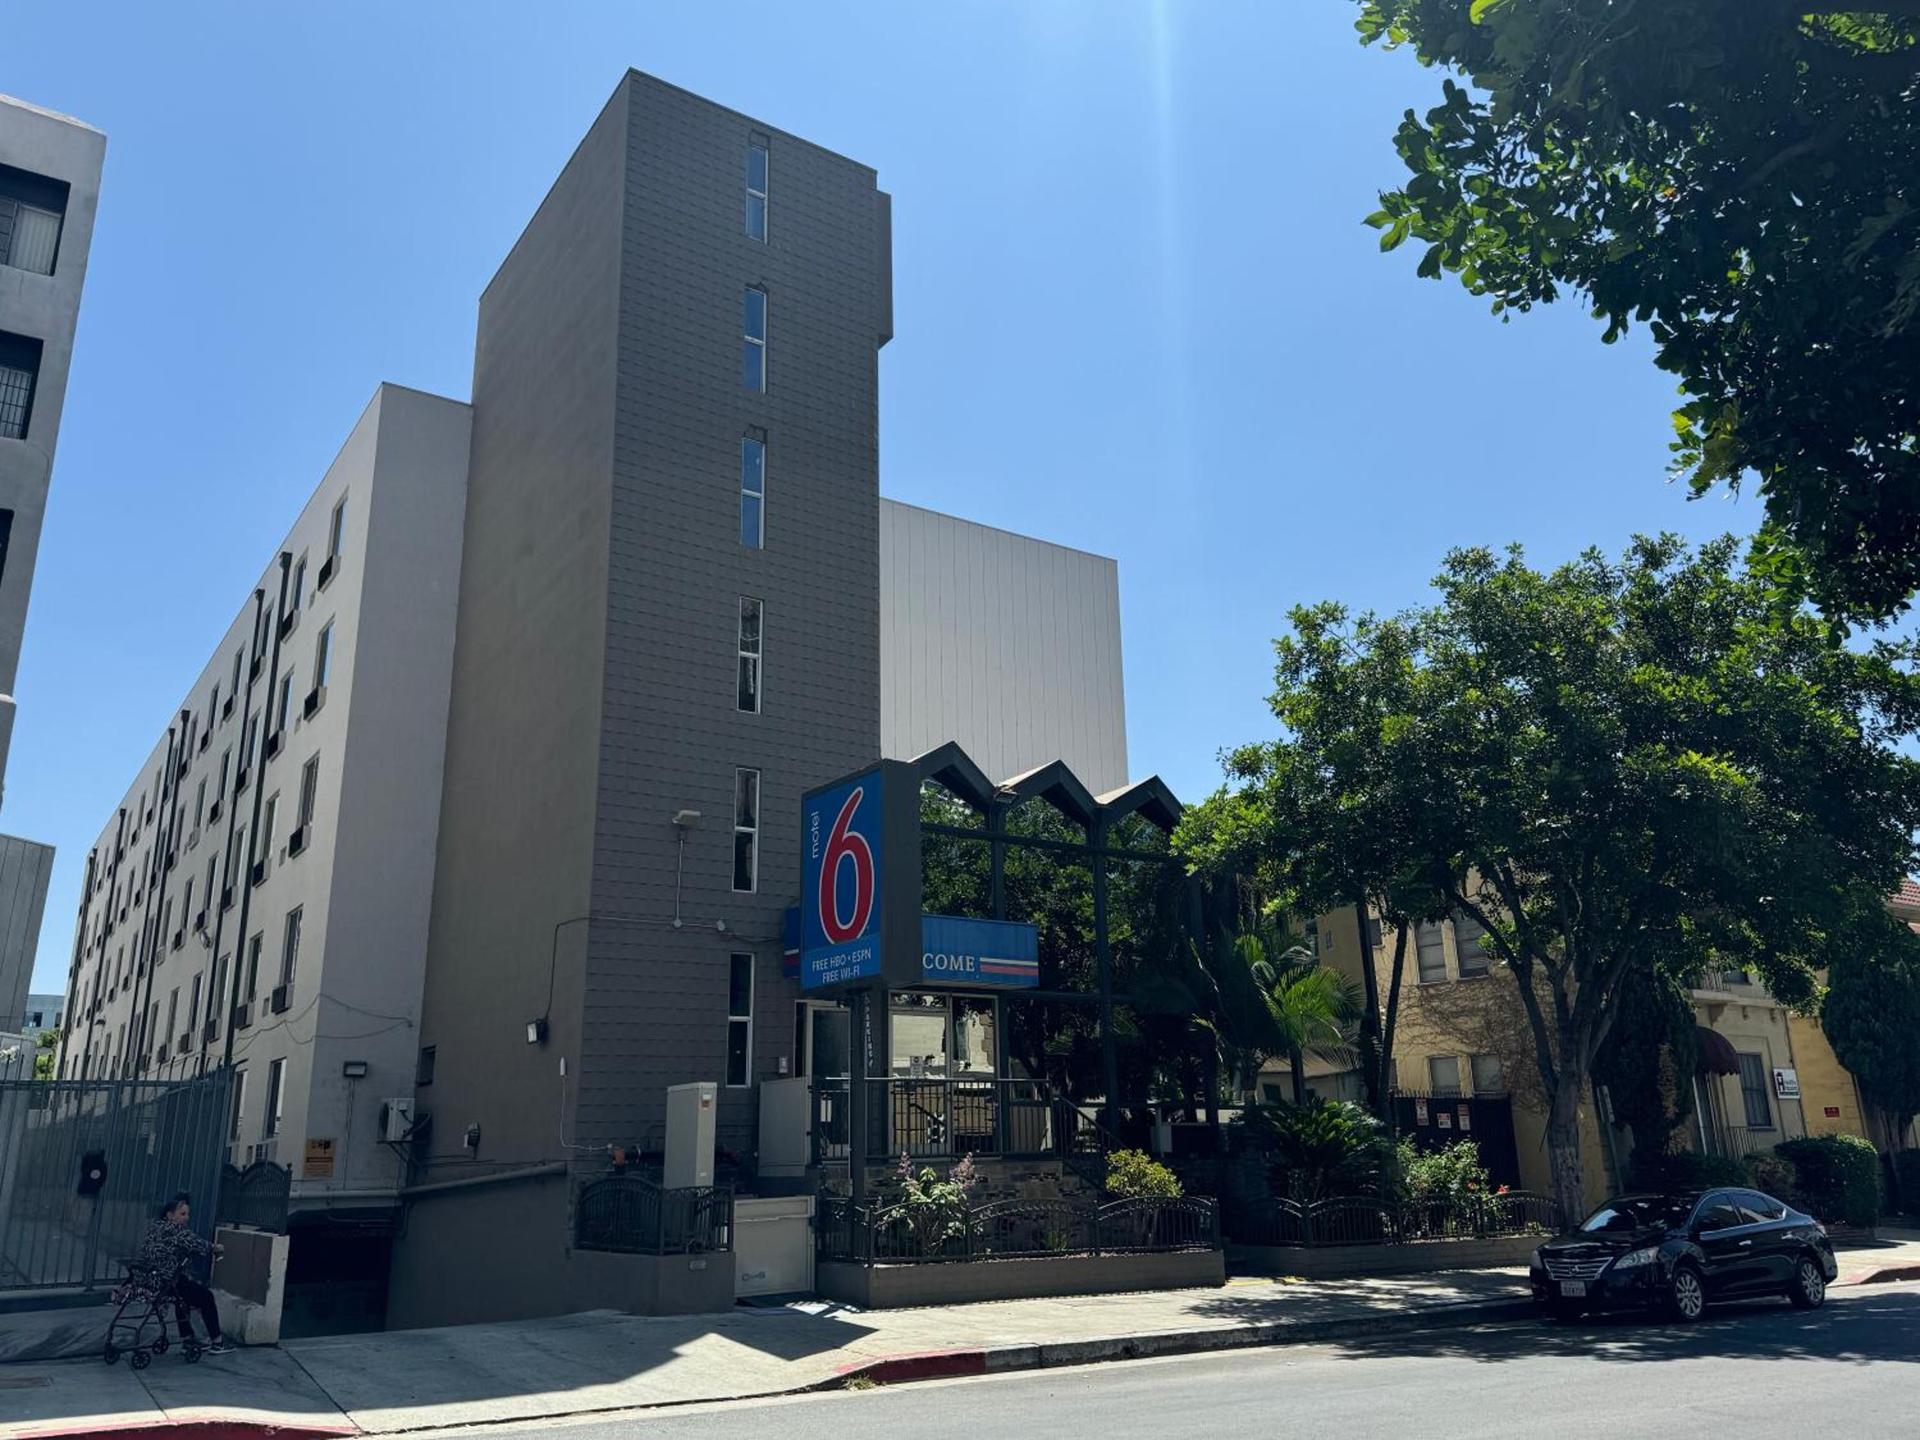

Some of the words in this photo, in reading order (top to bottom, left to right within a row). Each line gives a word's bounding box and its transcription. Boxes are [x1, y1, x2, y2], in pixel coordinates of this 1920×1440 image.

[810, 811, 820, 859] motel
[819, 786, 875, 944] 6
[812, 958, 829, 973] FREE
[830, 953, 847, 968] HBO
[852, 947, 872, 963] ESPN
[822, 969, 839, 984] FREE
[840, 964, 860, 980] WI-FI
